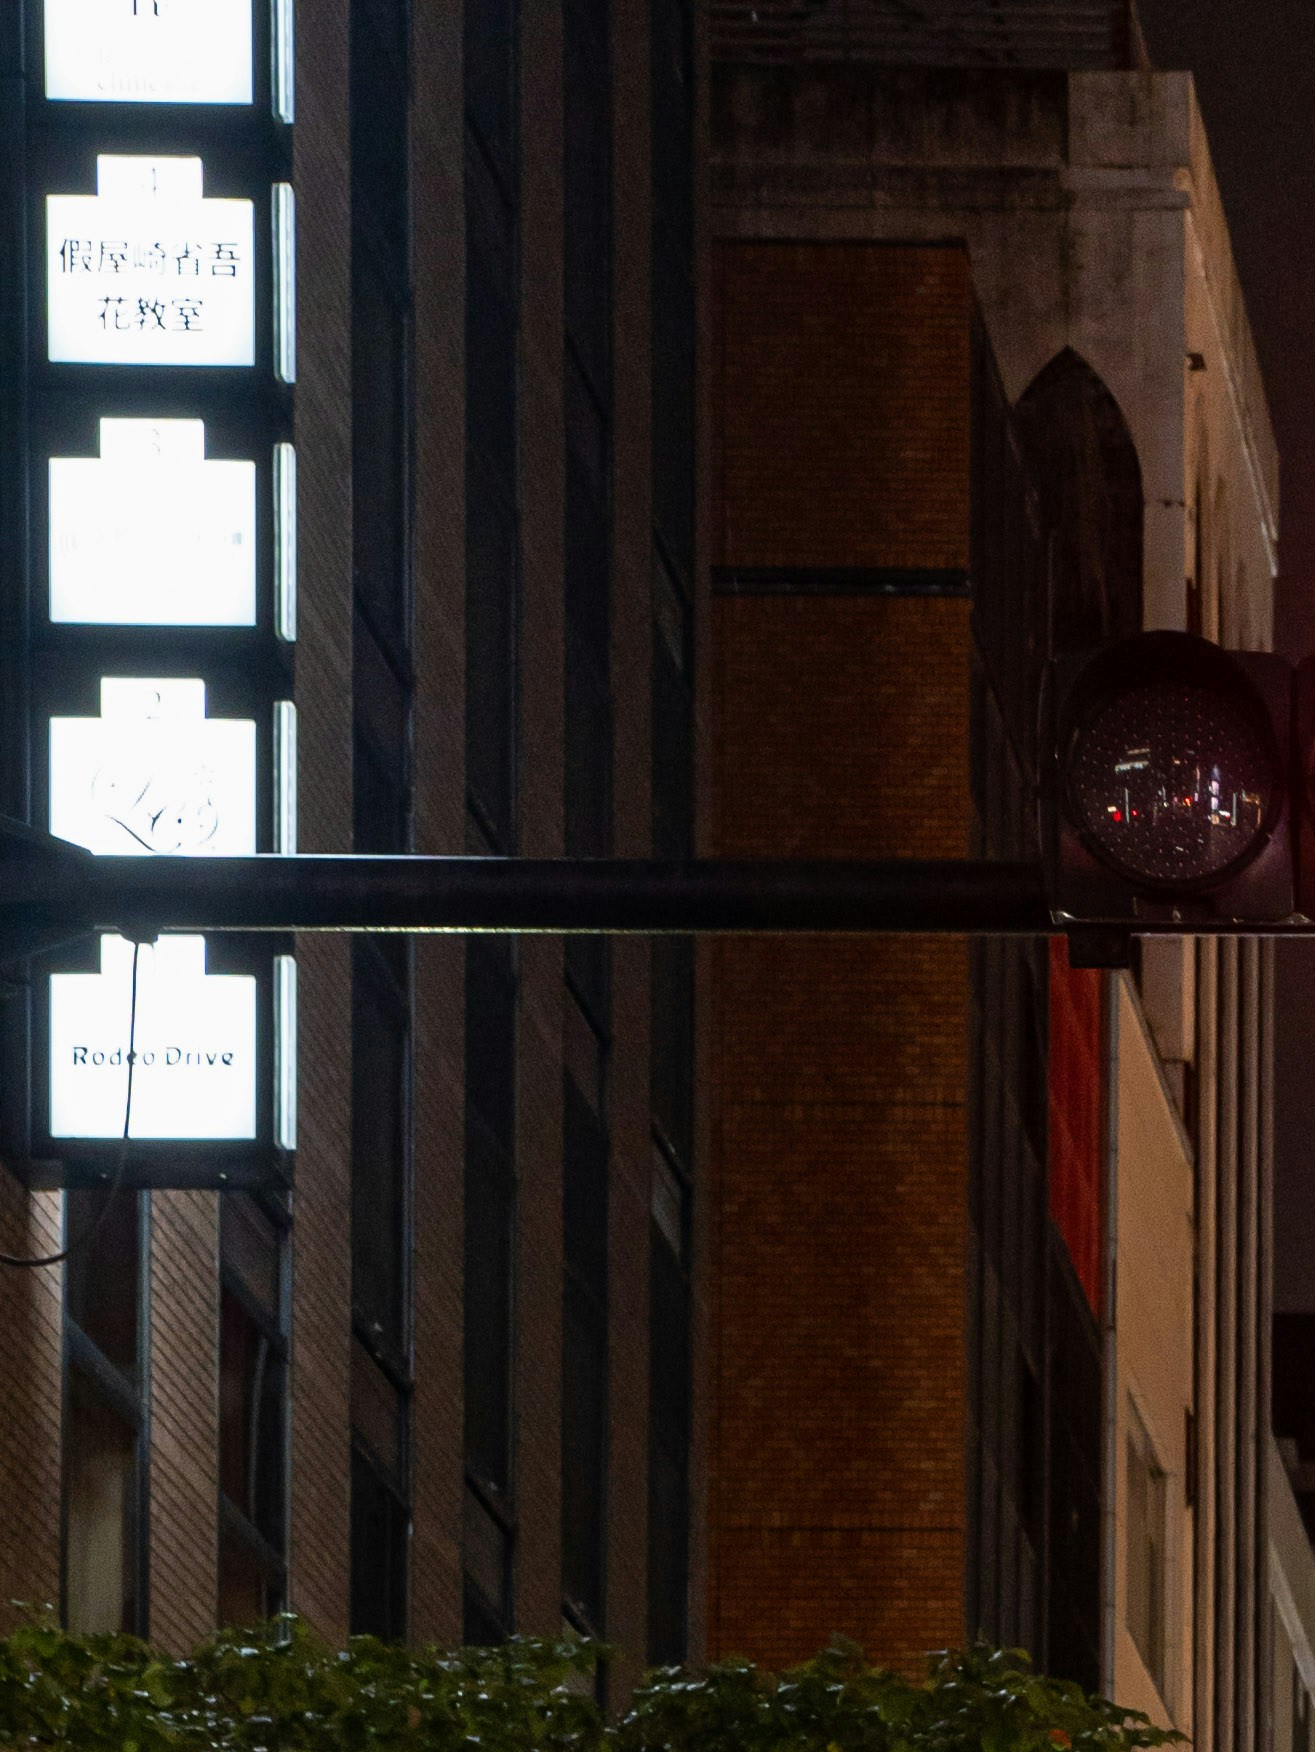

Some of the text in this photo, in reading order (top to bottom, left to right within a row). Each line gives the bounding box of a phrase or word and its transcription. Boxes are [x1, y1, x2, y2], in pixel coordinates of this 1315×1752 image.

[97, 294, 204, 332] 花教室
[165, 1046, 234, 1066] Drive
